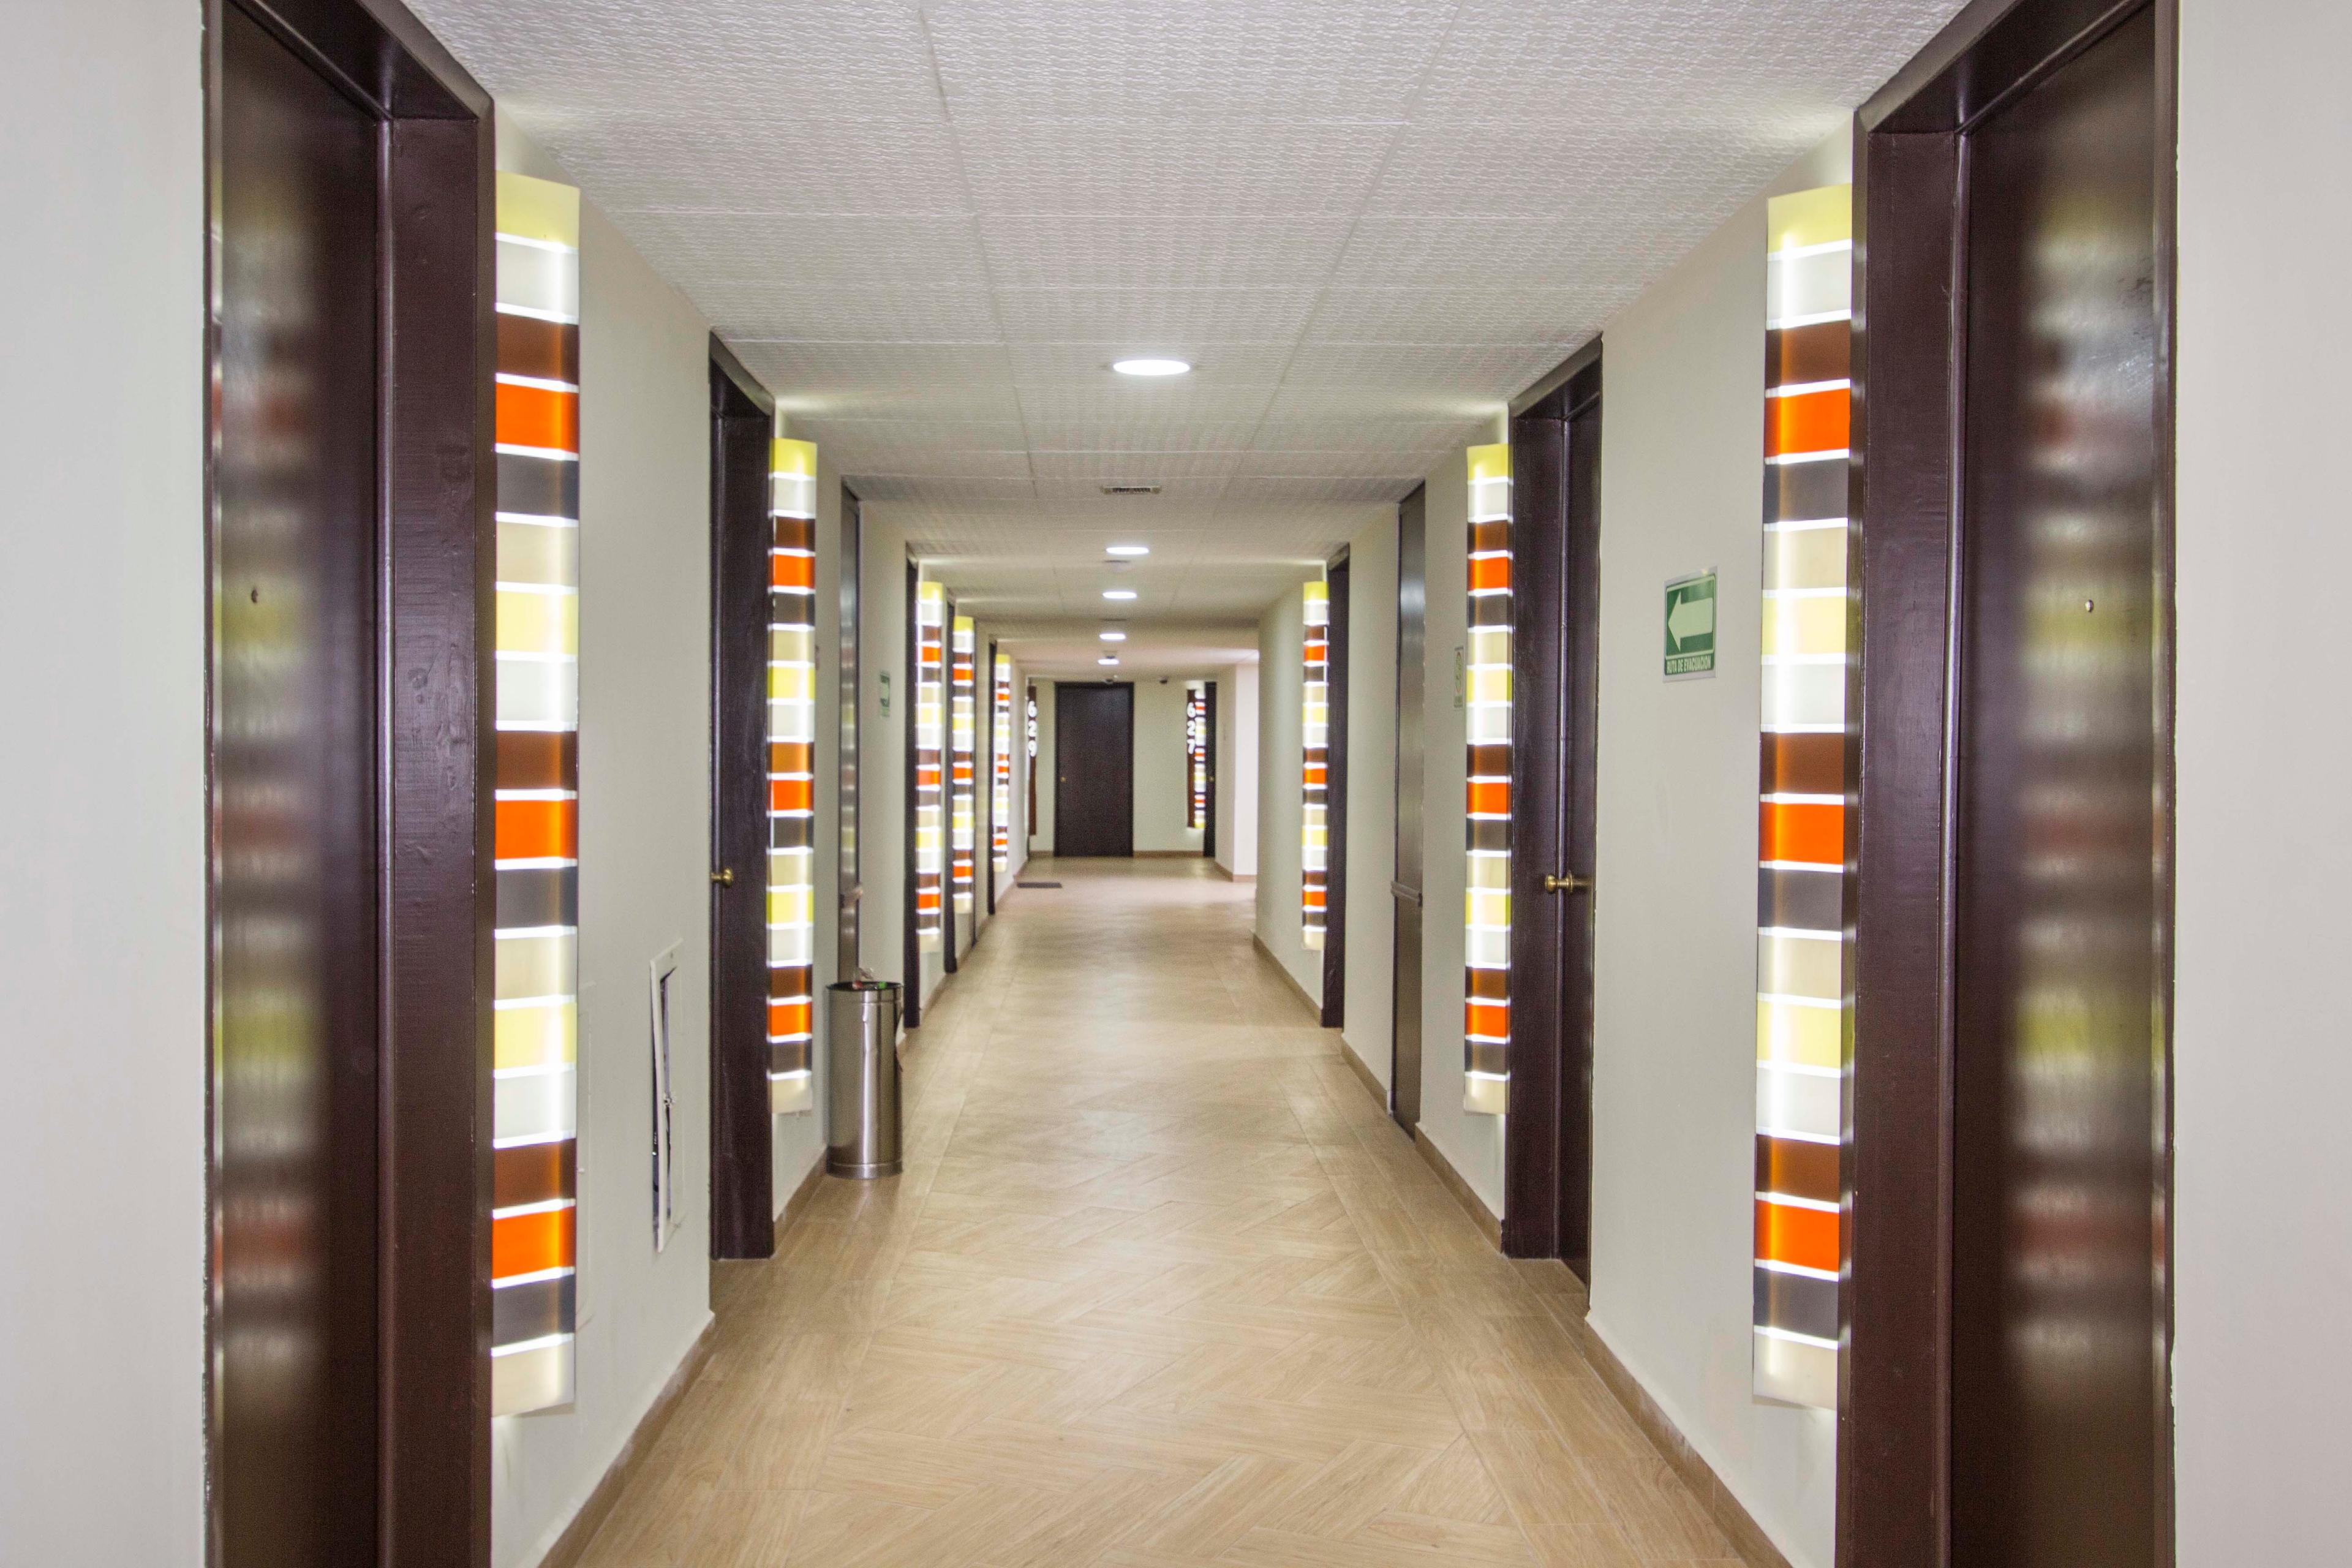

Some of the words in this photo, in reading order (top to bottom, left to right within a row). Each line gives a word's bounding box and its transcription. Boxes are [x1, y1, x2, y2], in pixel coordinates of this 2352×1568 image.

[1667, 660, 1677, 674] RUTA
[1678, 658, 1684, 673] DE
[1028, 701, 1038, 757] 629
[1187, 702, 1196, 754] 627
